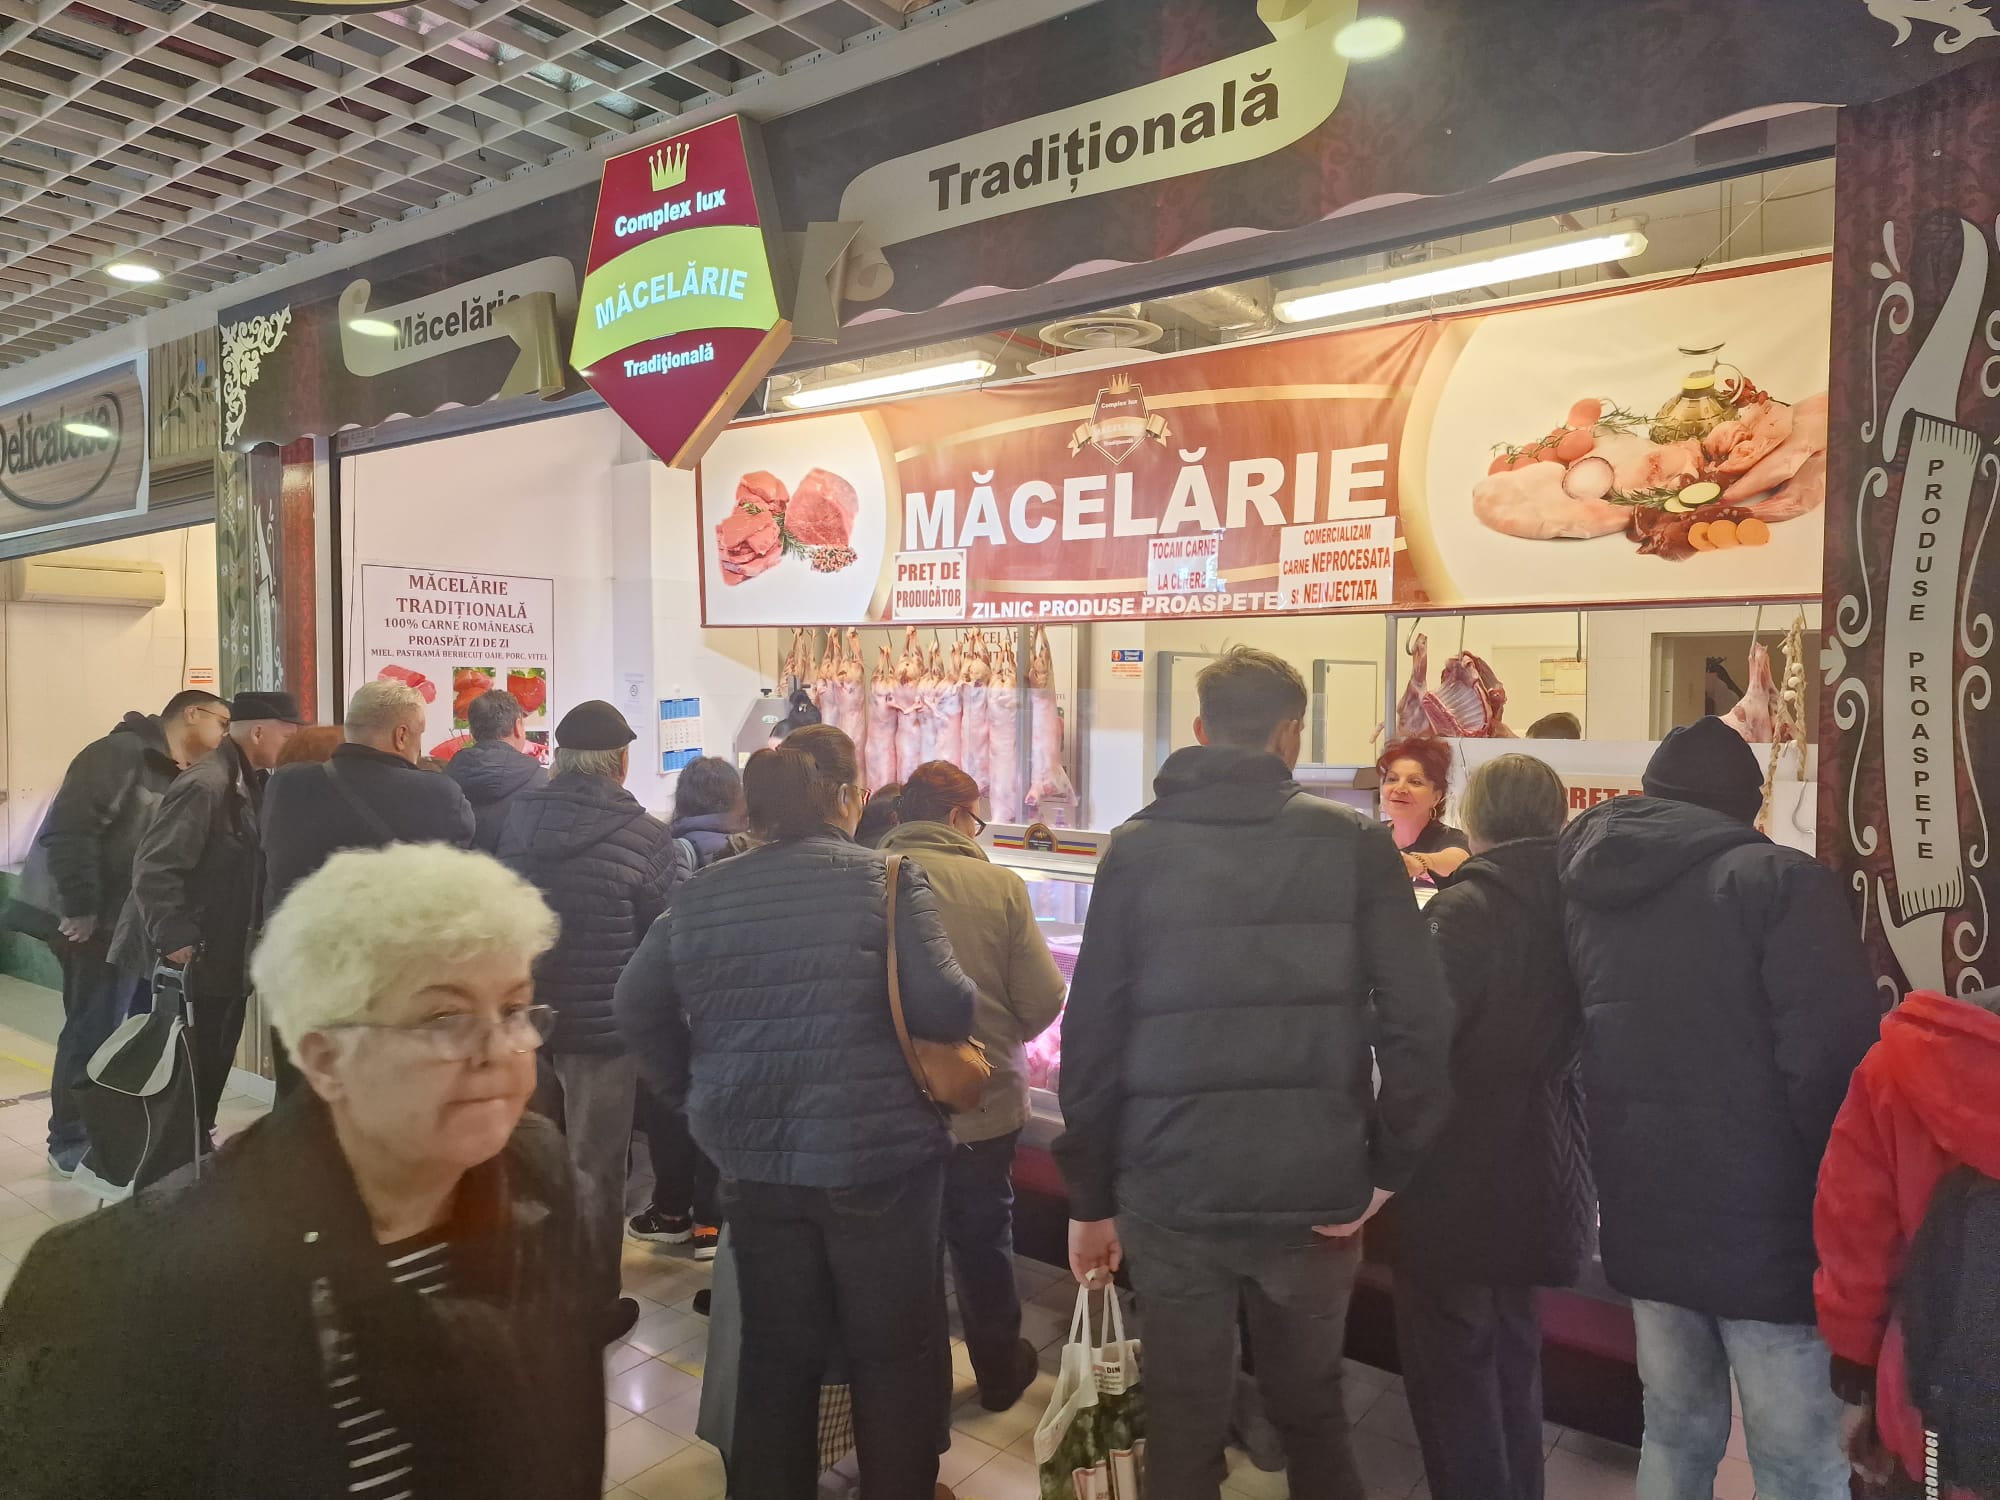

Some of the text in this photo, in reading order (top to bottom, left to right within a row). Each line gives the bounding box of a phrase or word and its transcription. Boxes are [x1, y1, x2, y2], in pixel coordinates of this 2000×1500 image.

[928, 68, 1280, 212] Tradițională
[614, 188, 726, 237] Complex lux
[594, 260, 748, 330] MĂCELĂRIE
[393, 289, 521, 351] Măcelăr
[905, 443, 1389, 550] MĂCELĂRIE
[1304, 524, 1372, 546] COMERCIALIZAM
[1153, 538, 1217, 560] TOCAM CARNE
[898, 562, 961, 585] PREȚ DE
[1283, 547, 1392, 576] CARNE NEPROCESATA
[409, 573, 508, 596] MĂCELĂRIE
[1157, 574, 1169, 591] LA
[1304, 579, 1378, 604] NEINJECTATA
[396, 597, 528, 619] TRADIȚIONALĂ
[897, 586, 961, 608] PRODUCĂTOR
[972, 592, 1279, 620] ZILNIC PRODUSE PROASPETE
[384, 617, 534, 634] 100% CARNE ROMÂNEASCĂ
[409, 634, 509, 649] PROASPĂT ZI DE ZI
[1908, 459, 1945, 859] PRODUSE PROASPETE
